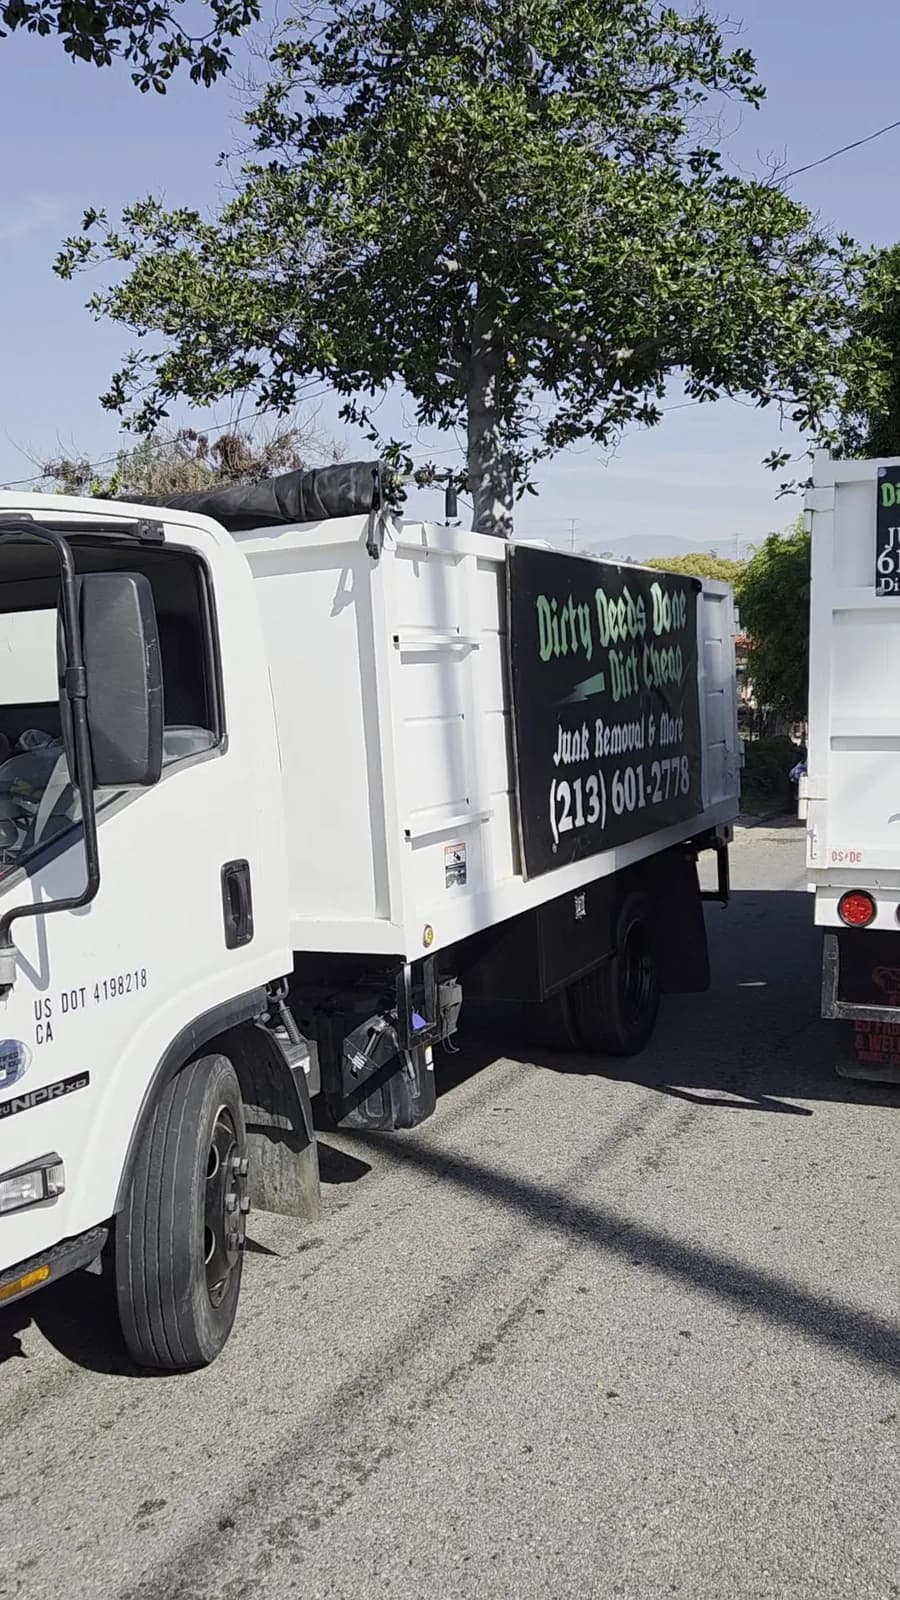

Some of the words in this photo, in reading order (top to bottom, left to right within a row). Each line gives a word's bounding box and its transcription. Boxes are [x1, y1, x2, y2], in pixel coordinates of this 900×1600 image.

[536, 593, 593, 662] Dirty
[594, 585, 647, 647] Deeds
[650, 582, 687, 636] Done
[608, 643, 640, 703] Dirt
[643, 642, 683, 690] Cheap
[553, 721, 590, 767] Junk
[594, 713, 645, 758] Removal
[648, 714, 656, 748] &
[660, 712, 683, 745] More
[550, 769, 606, 844] (213)
[611, 755, 690, 815] 601-2778
[34, 998, 52, 1021] US
[61, 987, 87, 1013] DOT
[93, 968, 147, 1004] 4198218
[36, 1021, 53, 1045] CA
